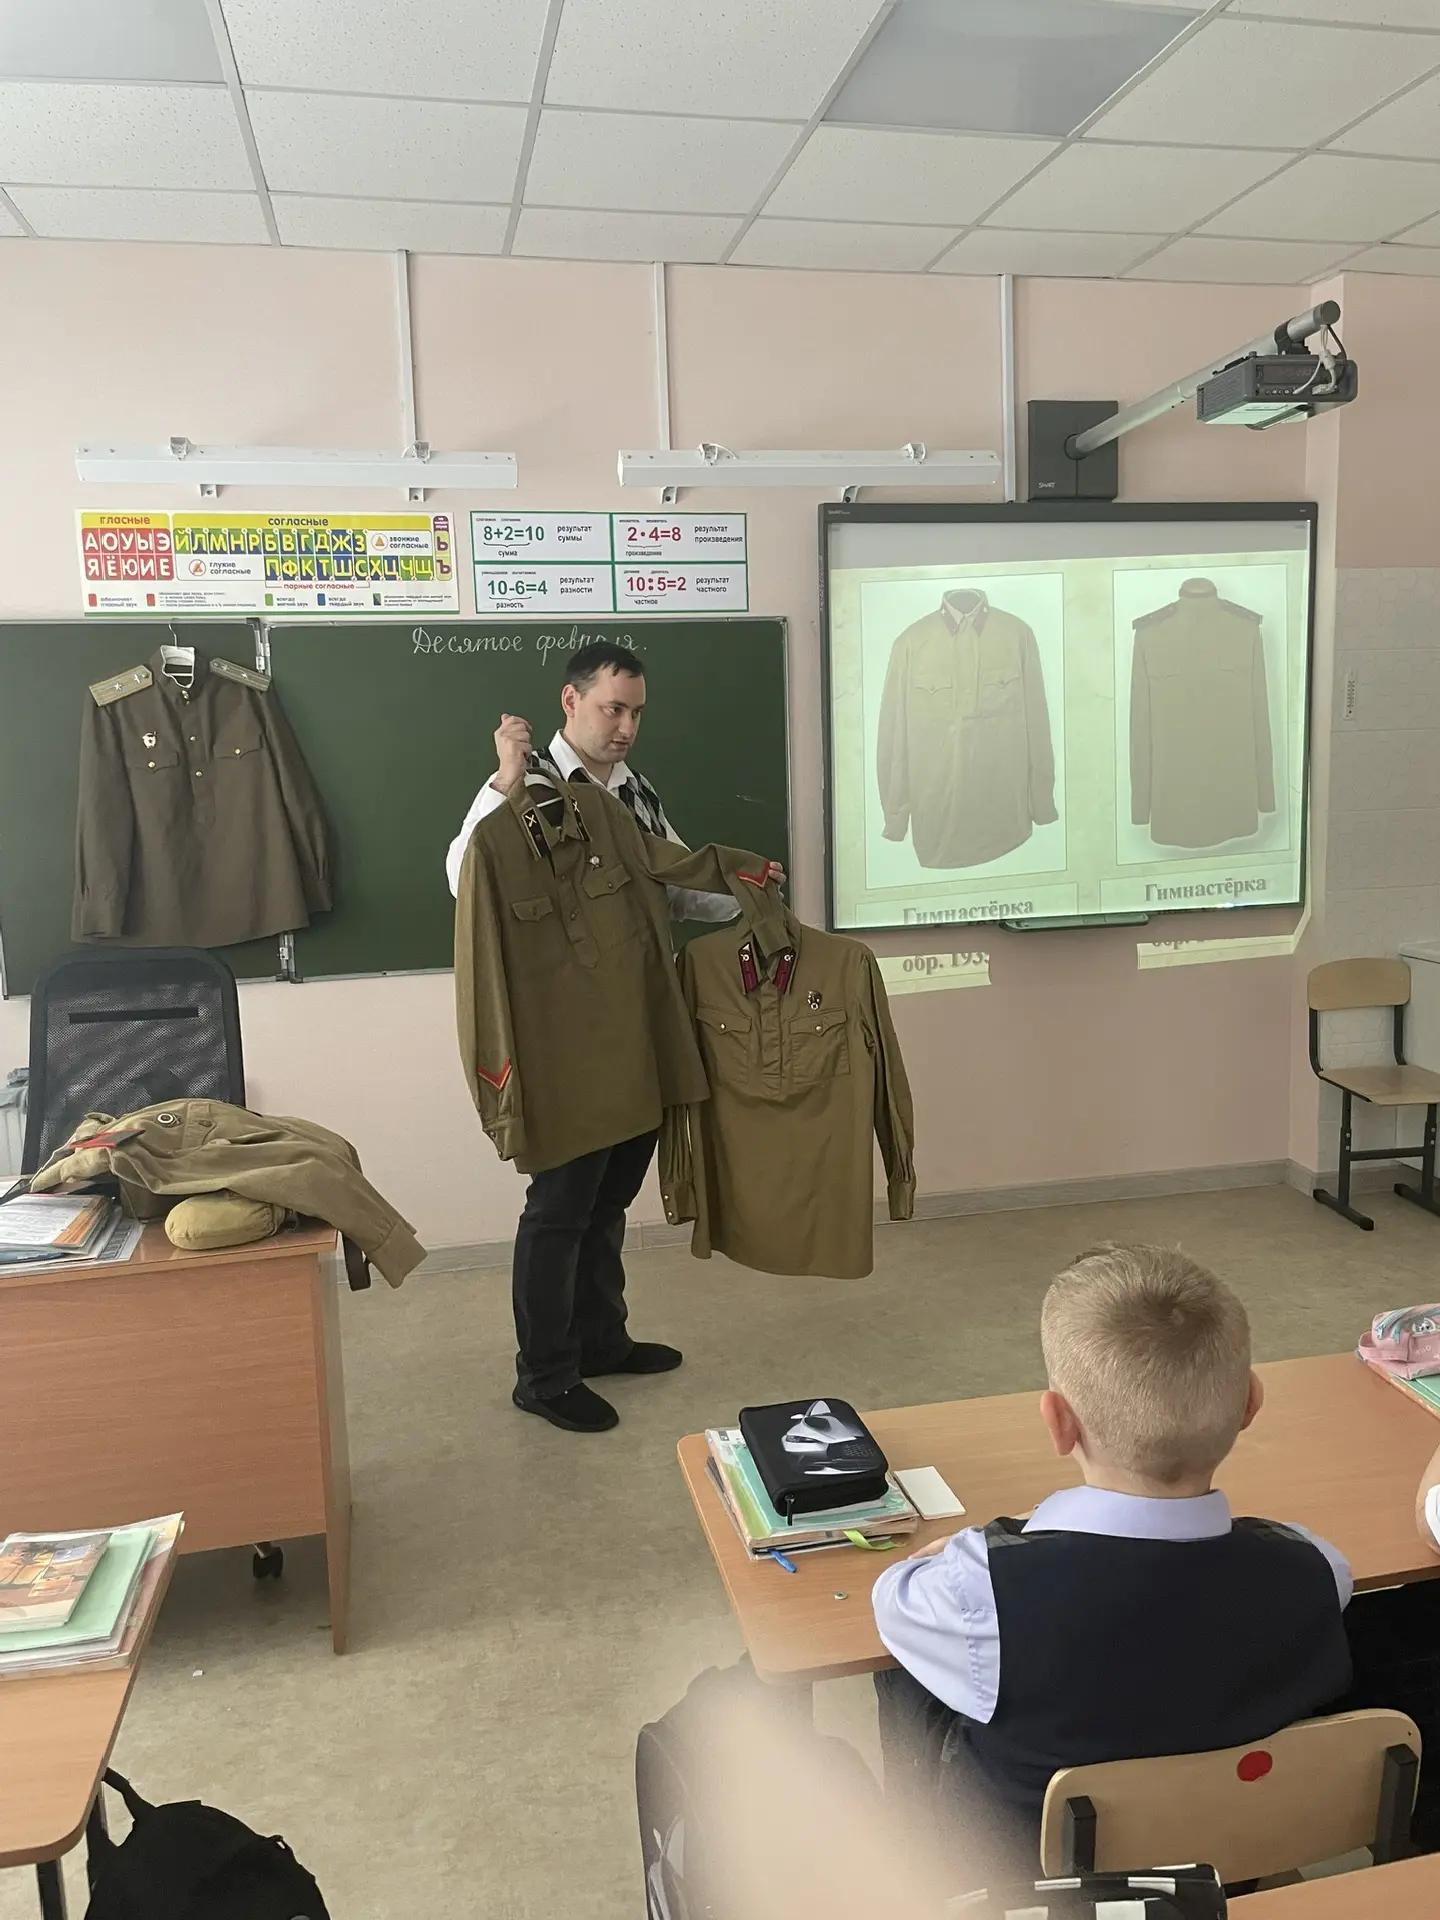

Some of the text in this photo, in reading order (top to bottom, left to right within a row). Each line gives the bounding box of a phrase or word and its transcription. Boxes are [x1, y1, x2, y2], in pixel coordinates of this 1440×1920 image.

[100, 516, 150, 525] гласные
[268, 518, 329, 526] согласные
[483, 525, 544, 541] 8+2=10
[557, 525, 592, 533] результат
[694, 525, 728, 533] результат
[557, 535, 582, 543] суммы
[694, 536, 743, 544] произведения
[498, 550, 518, 558] сумма
[559, 577, 594, 585] результат
[695, 577, 730, 585] результат
[487, 580, 548, 595] 10-6=4
[560, 586, 593, 595] разности
[496, 601, 524, 609] разность
[412, 625, 647, 666] Десятое февря.
[1144, 877, 1267, 902] Гимнастёрка
[903, 900, 1034, 925] Гимнастёрка
[951, 951, 990, 967] 193
